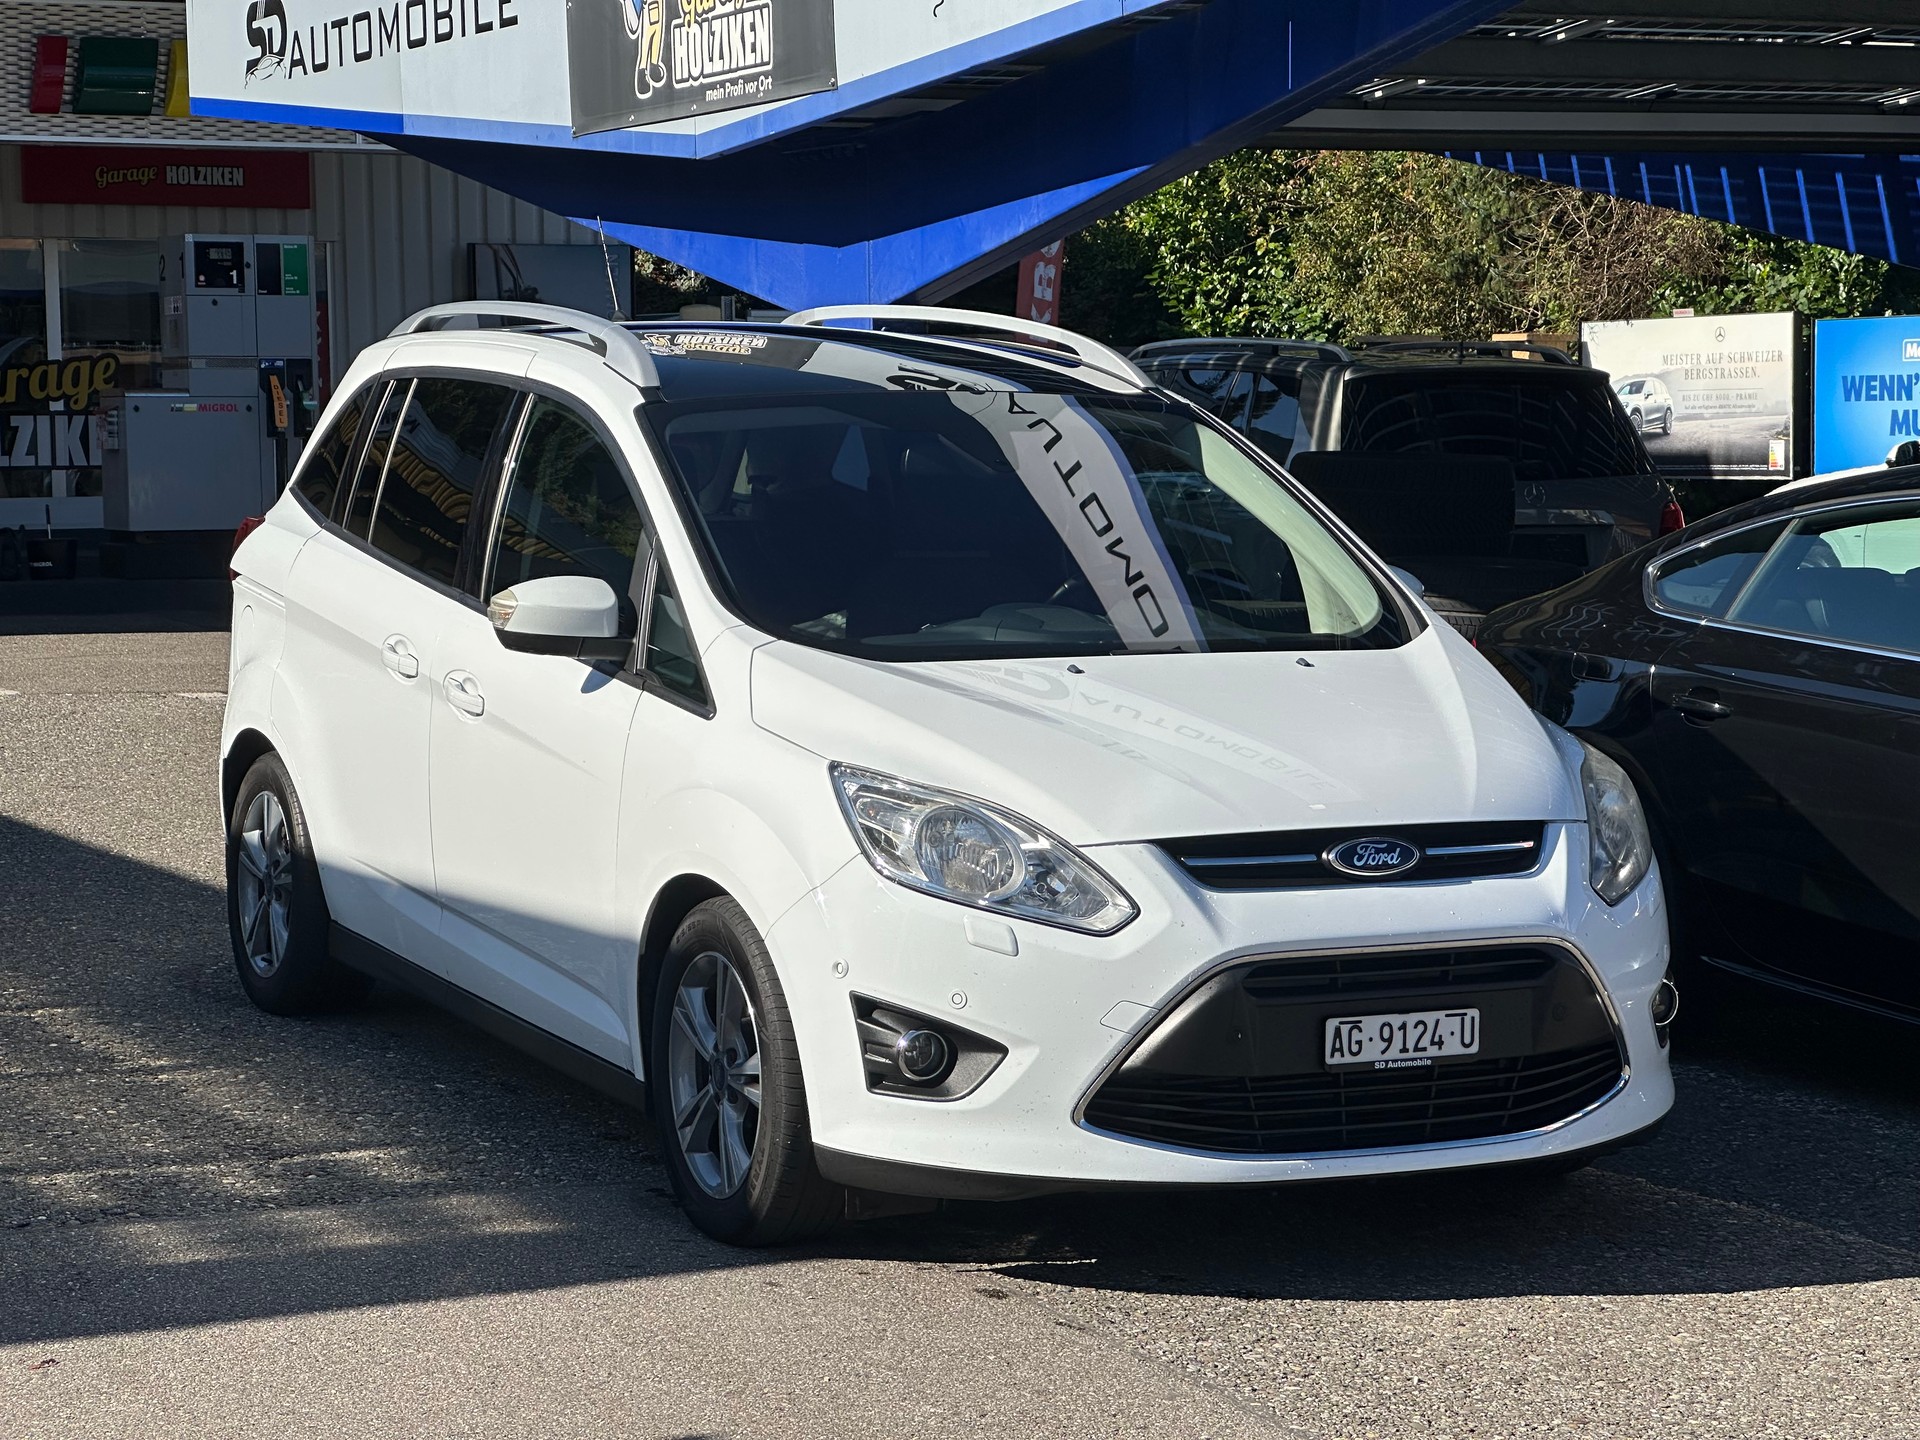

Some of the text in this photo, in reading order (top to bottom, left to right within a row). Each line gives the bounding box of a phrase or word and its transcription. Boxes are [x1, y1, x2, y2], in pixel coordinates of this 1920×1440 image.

[673, 7, 769, 80] HOLZIKEN
[705, 75, 773, 102] mein Profi vor Ort
[95, 165, 244, 189] Garage HOLZIKEN
[229, 269, 238, 285] 1
[1662, 350, 1784, 366] MEISTER AUF SCHWEIZER
[0, 357, 117, 411] rage
[1684, 366, 1760, 380] BERGSTRASSEN.
[1841, 372, 1920, 402] WENN'
[198, 403, 239, 412] MIGROL
[273, 384, 284, 424] DIESEL
[0, 415, 102, 466] ZIK
[1353, 843, 1401, 867] Ford
[1374, 1058, 1432, 1069] SD Automobile
